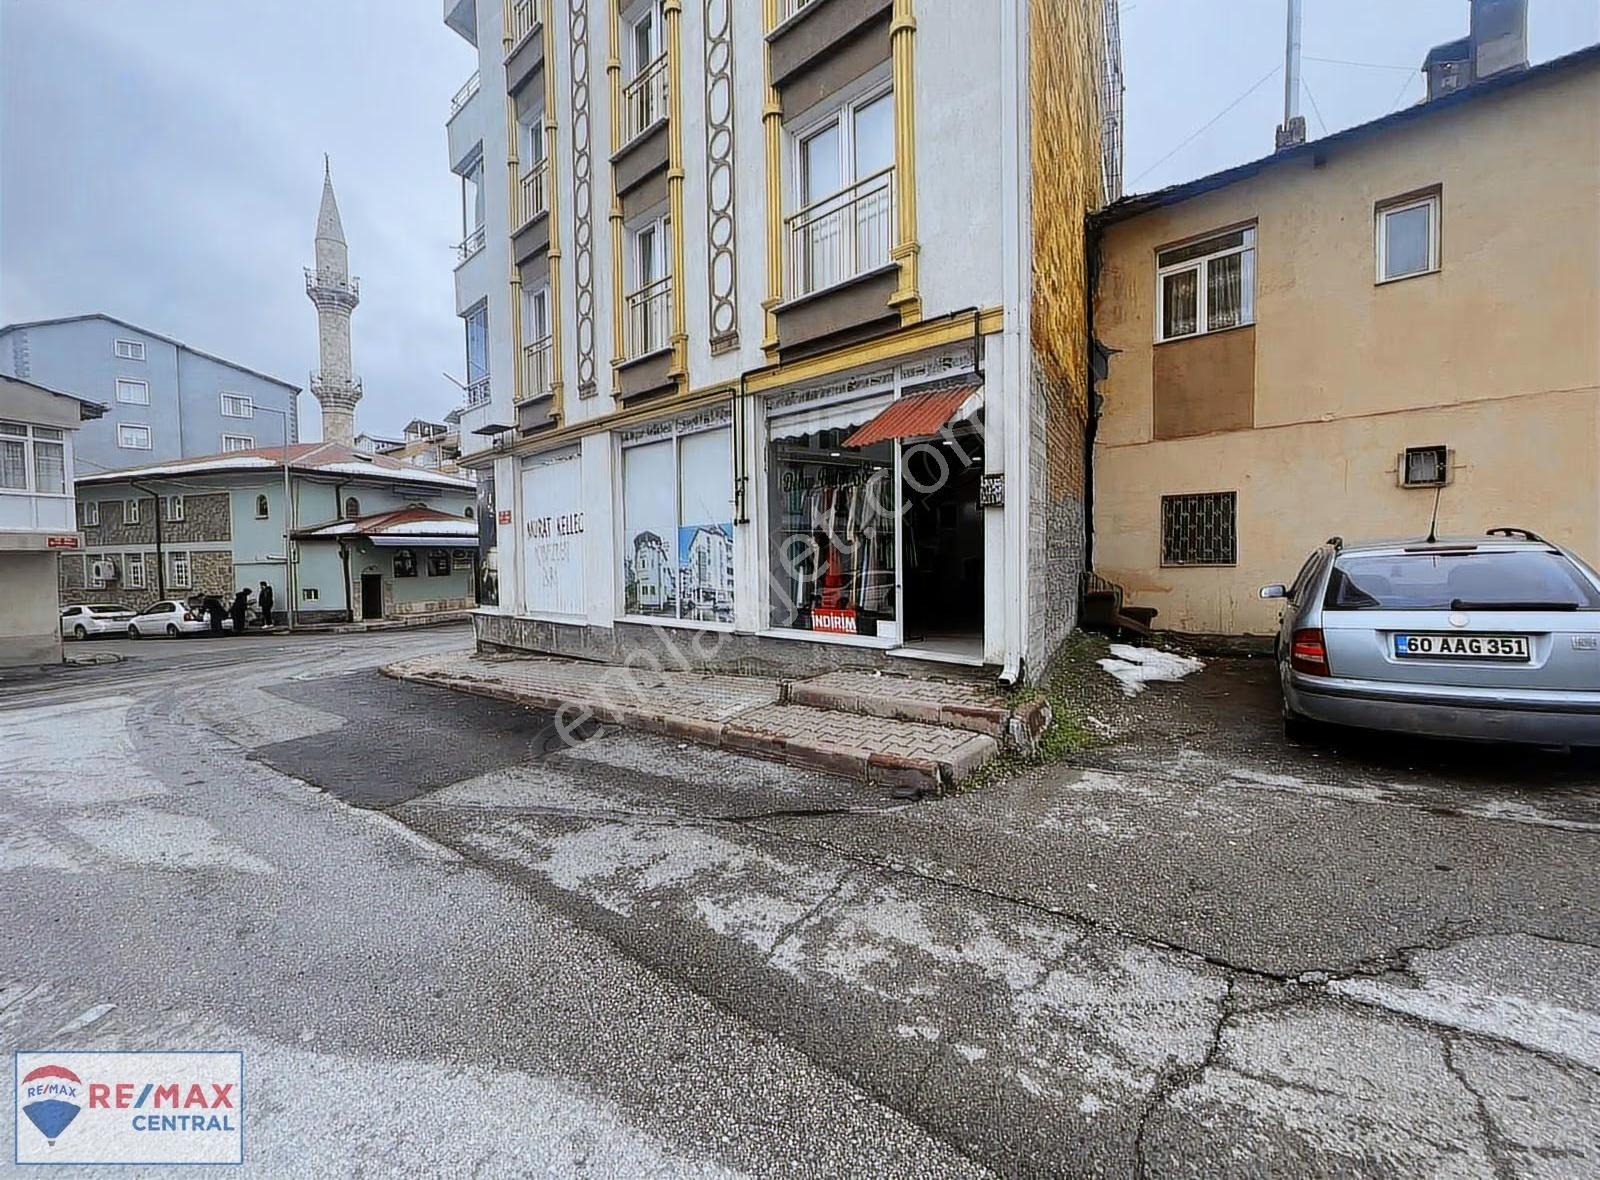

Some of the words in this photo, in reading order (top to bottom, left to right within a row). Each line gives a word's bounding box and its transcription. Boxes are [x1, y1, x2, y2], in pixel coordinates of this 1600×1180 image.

[1407, 638, 1432, 652] 60
[1439, 639, 1482, 654] AAG
[1487, 639, 1526, 655] 351
